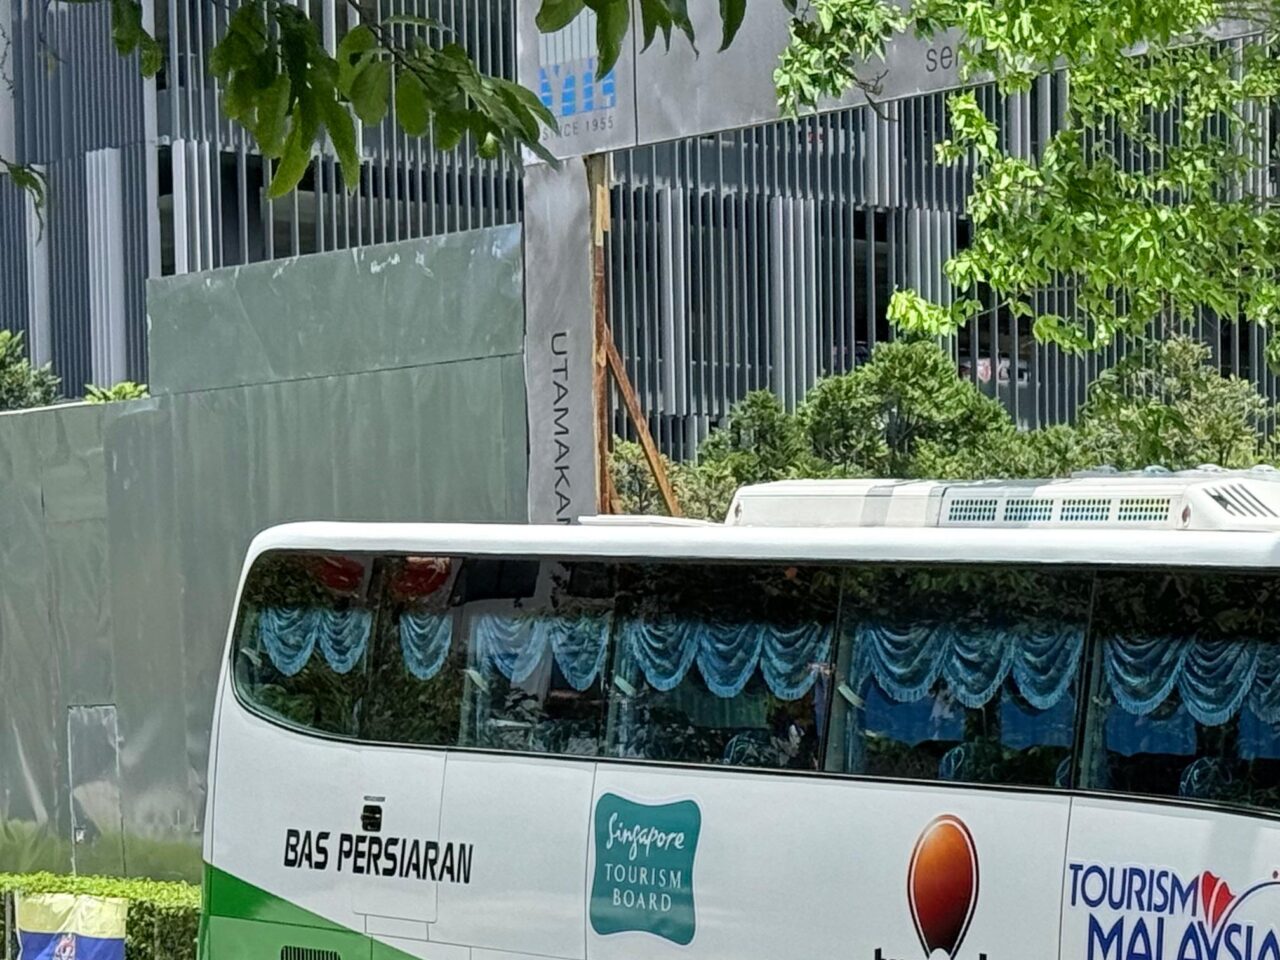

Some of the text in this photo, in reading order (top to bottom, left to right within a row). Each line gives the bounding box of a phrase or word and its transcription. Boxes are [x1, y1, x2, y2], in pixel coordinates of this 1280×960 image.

[542, 115, 614, 141] SCE 1955
[606, 812, 685, 861] Singapore
[284, 829, 474, 884] BAS PERSIARAN
[605, 863, 682, 888] TOURISM
[1069, 864, 1200, 917] TOURISM
[612, 888, 672, 912] BOARD
